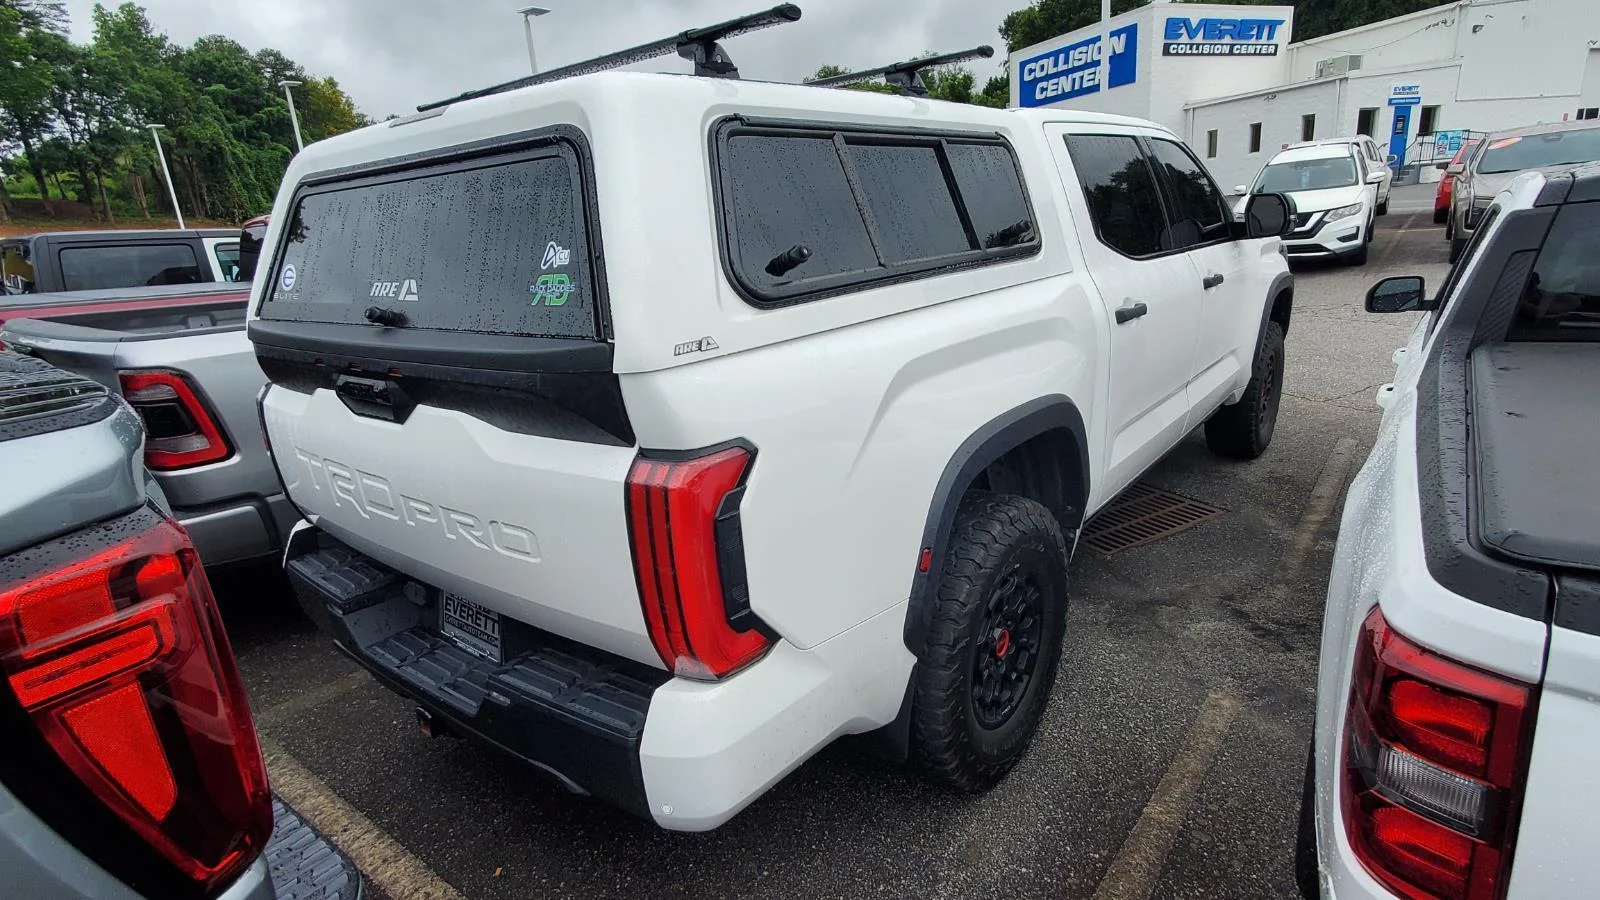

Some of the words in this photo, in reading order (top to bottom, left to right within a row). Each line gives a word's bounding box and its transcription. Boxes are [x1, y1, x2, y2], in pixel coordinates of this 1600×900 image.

[1164, 17, 1286, 41] EVERETT
[1023, 33, 1127, 82] COLLISION
[1168, 44, 1229, 54] COLLISION
[1232, 44, 1276, 54] CENTER
[295, 447, 399, 519] TRD
[399, 494, 542, 564] PRO
[445, 596, 499, 635] EVERETT
